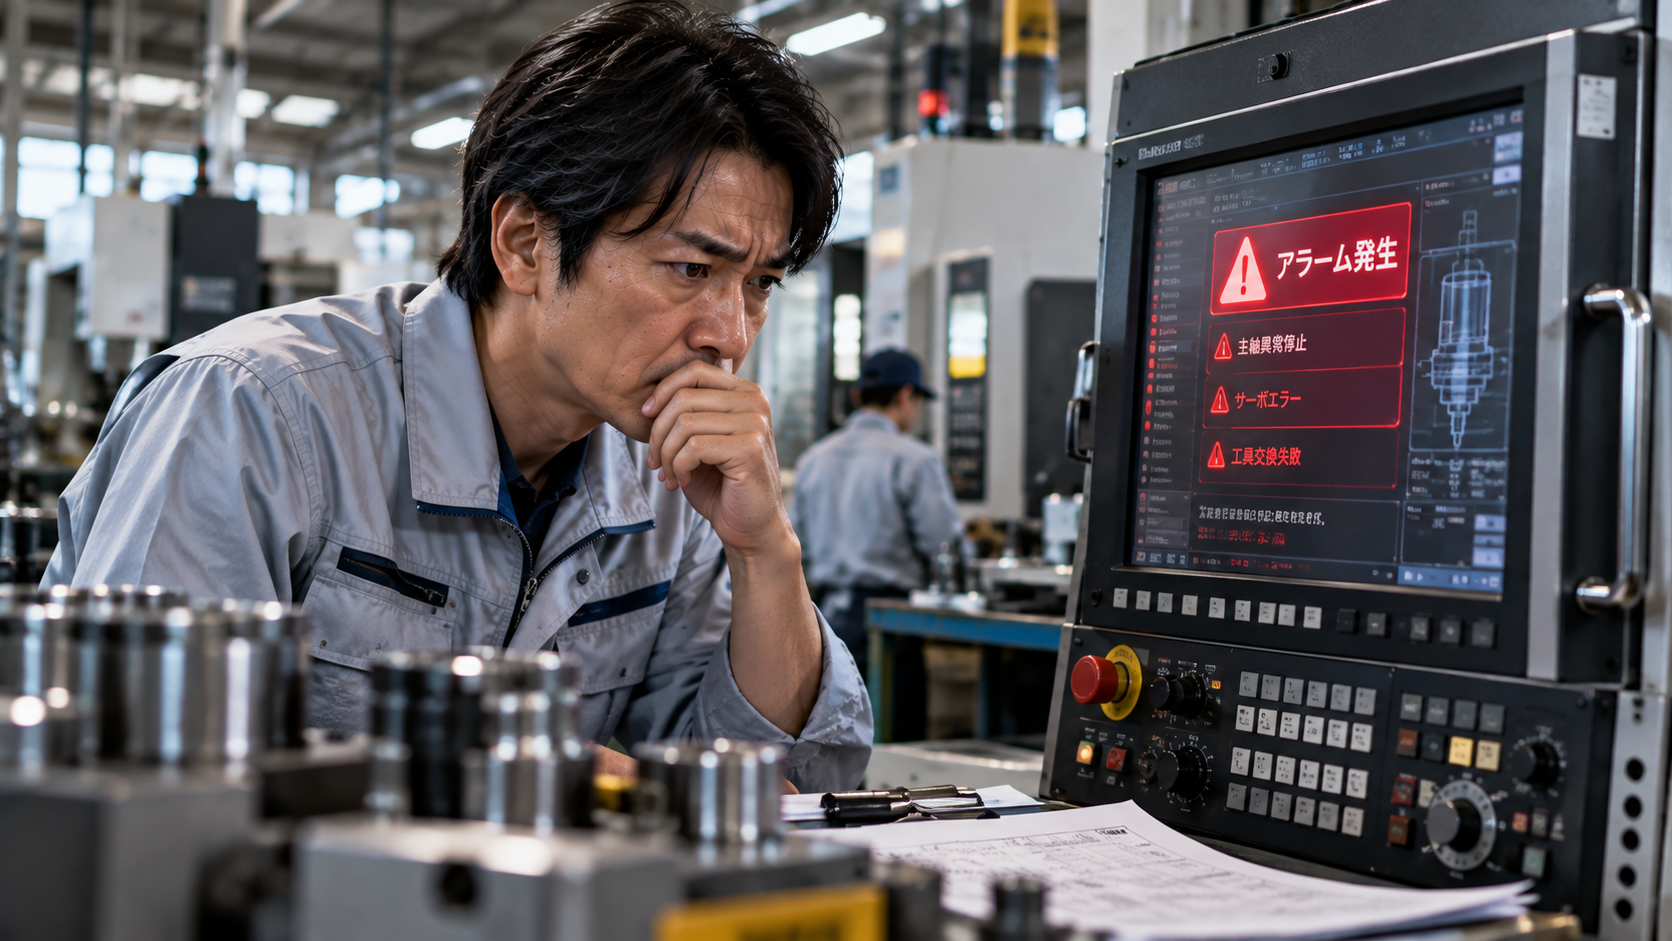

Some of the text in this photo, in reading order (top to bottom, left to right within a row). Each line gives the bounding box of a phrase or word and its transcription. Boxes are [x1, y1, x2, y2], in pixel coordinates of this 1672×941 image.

[1277, 236, 1398, 280] アラーム発生
[1235, 391, 1302, 409] サーボエラー
[1231, 447, 1302, 466] 工具交換失敗
